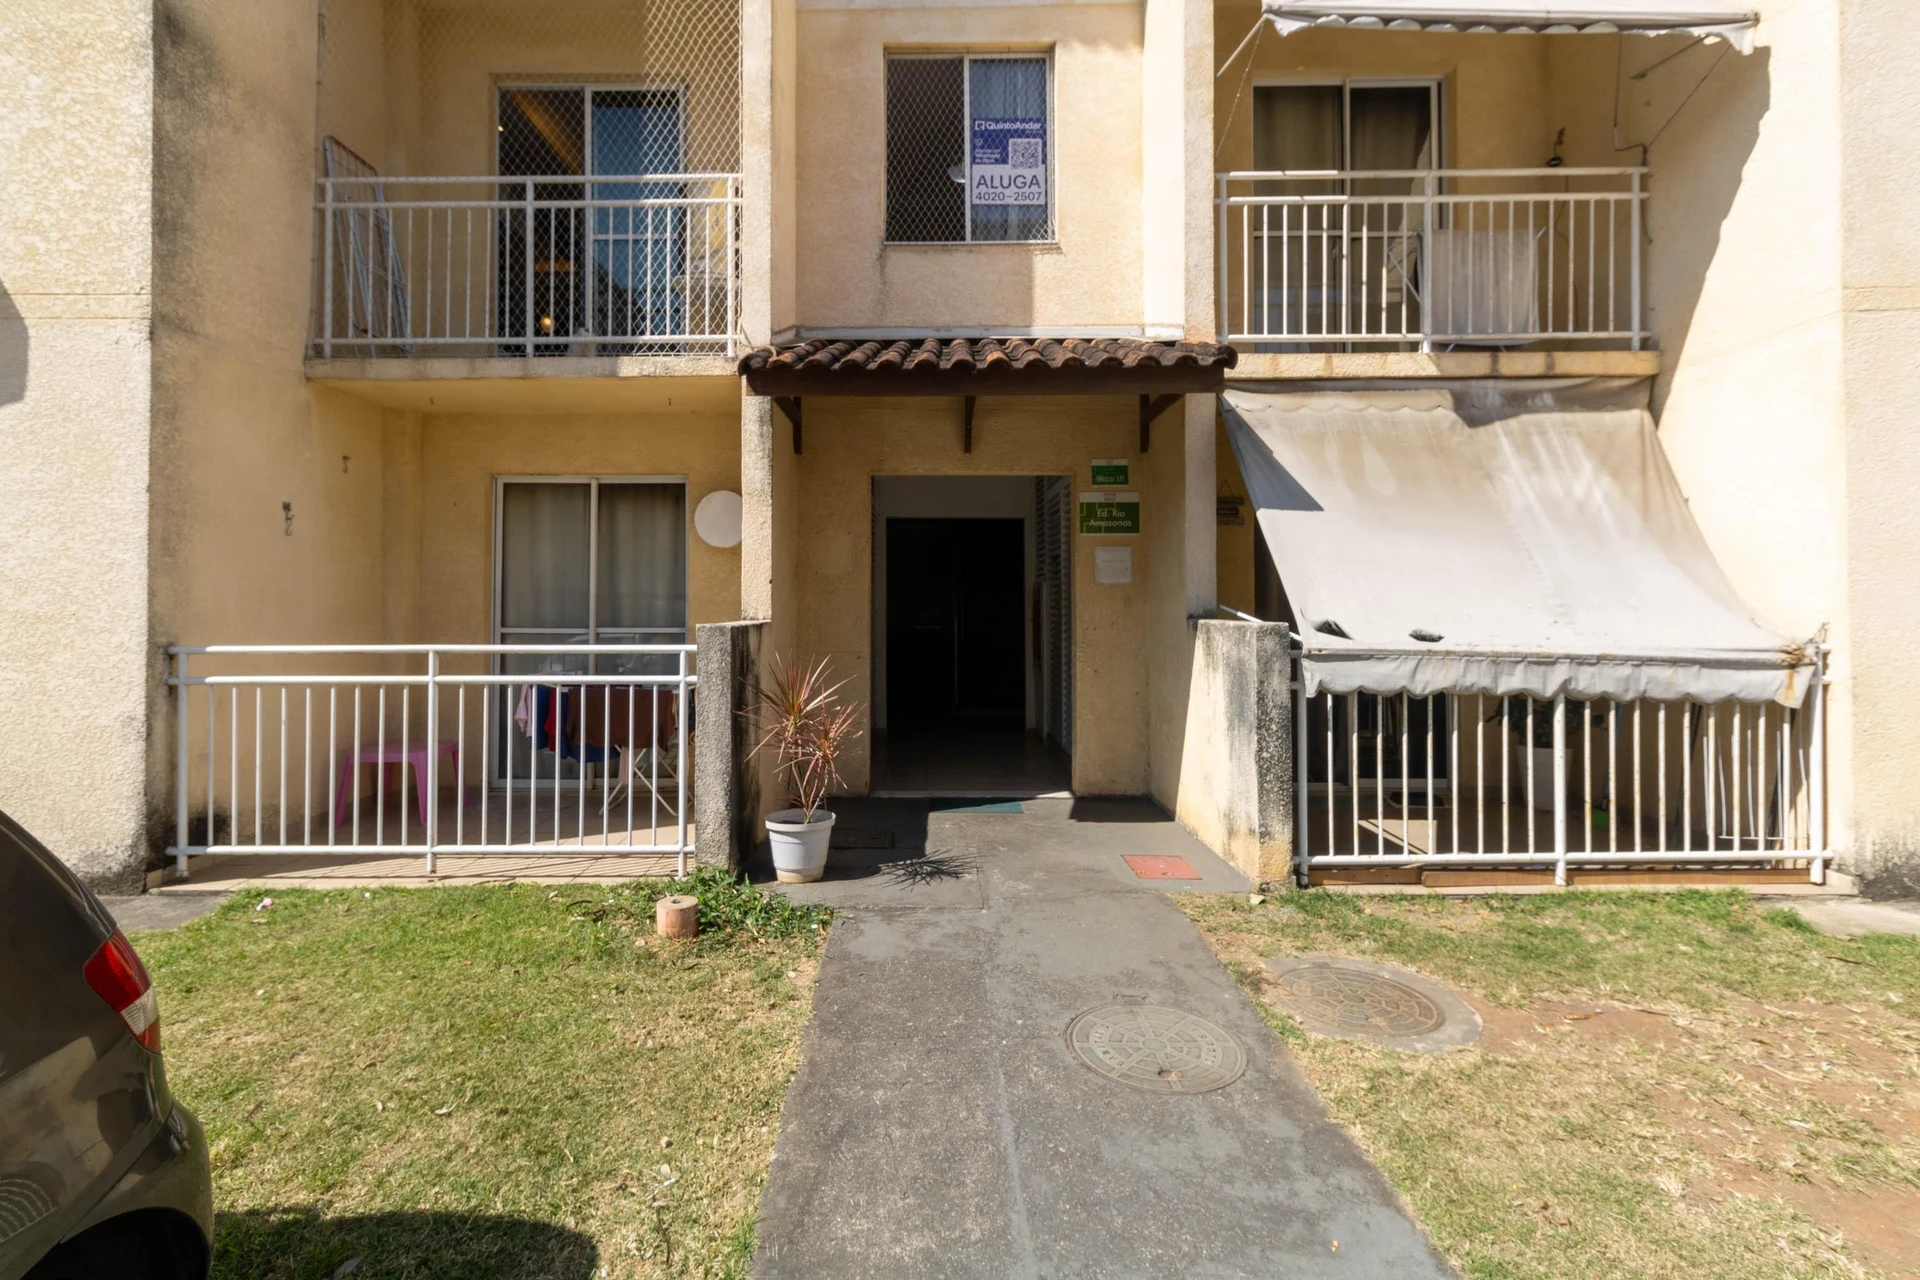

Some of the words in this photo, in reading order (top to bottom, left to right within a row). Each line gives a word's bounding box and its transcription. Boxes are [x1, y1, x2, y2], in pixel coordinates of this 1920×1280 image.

[986, 121, 1042, 130] QuintoAndar
[976, 175, 1041, 189] ALUGA
[975, 191, 1042, 201] 4020-2507
[1097, 509, 1110, 517] Ed.
[1112, 509, 1125, 517] Rio
[1089, 519, 1132, 527] Amazonas
